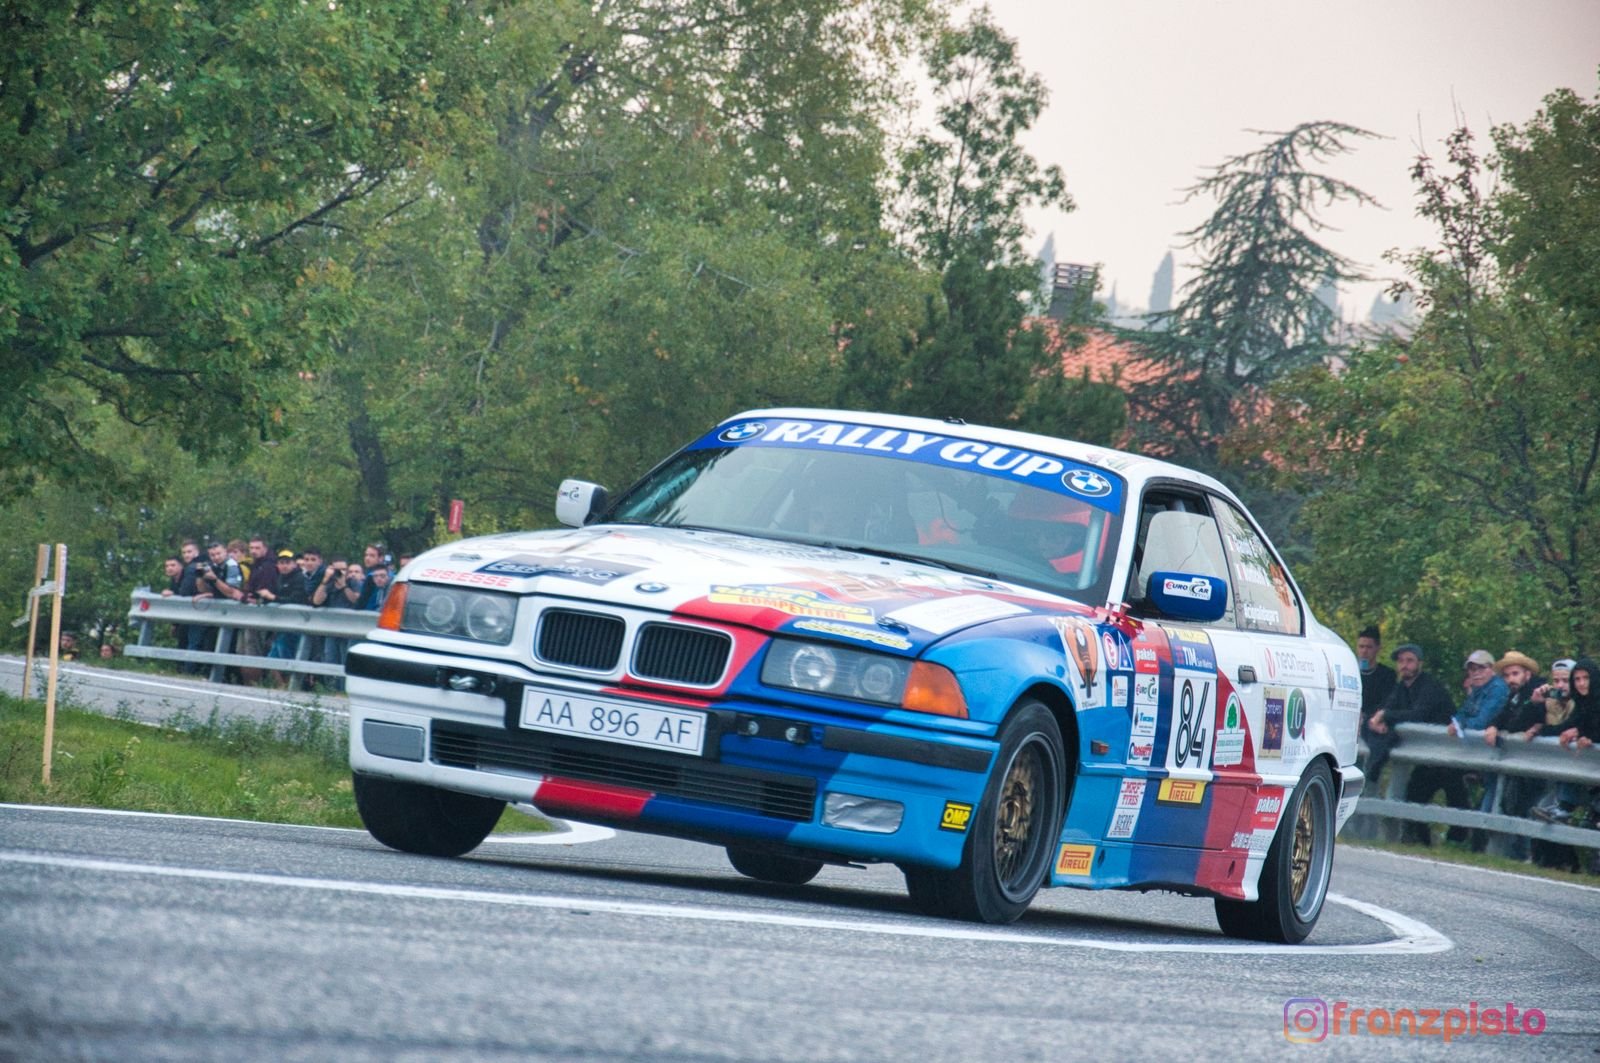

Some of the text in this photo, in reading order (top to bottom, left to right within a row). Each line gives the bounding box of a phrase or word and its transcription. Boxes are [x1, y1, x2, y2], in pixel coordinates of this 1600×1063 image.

[761, 421, 1064, 477] RALLY CUP
[536, 698, 693, 744] AA 896 AF
[1175, 678, 1210, 769] 84
[1168, 780, 1197, 801] PIRELLI
[1255, 796, 1281, 816] pakelo
[1060, 849, 1091, 870] PIRELLI
